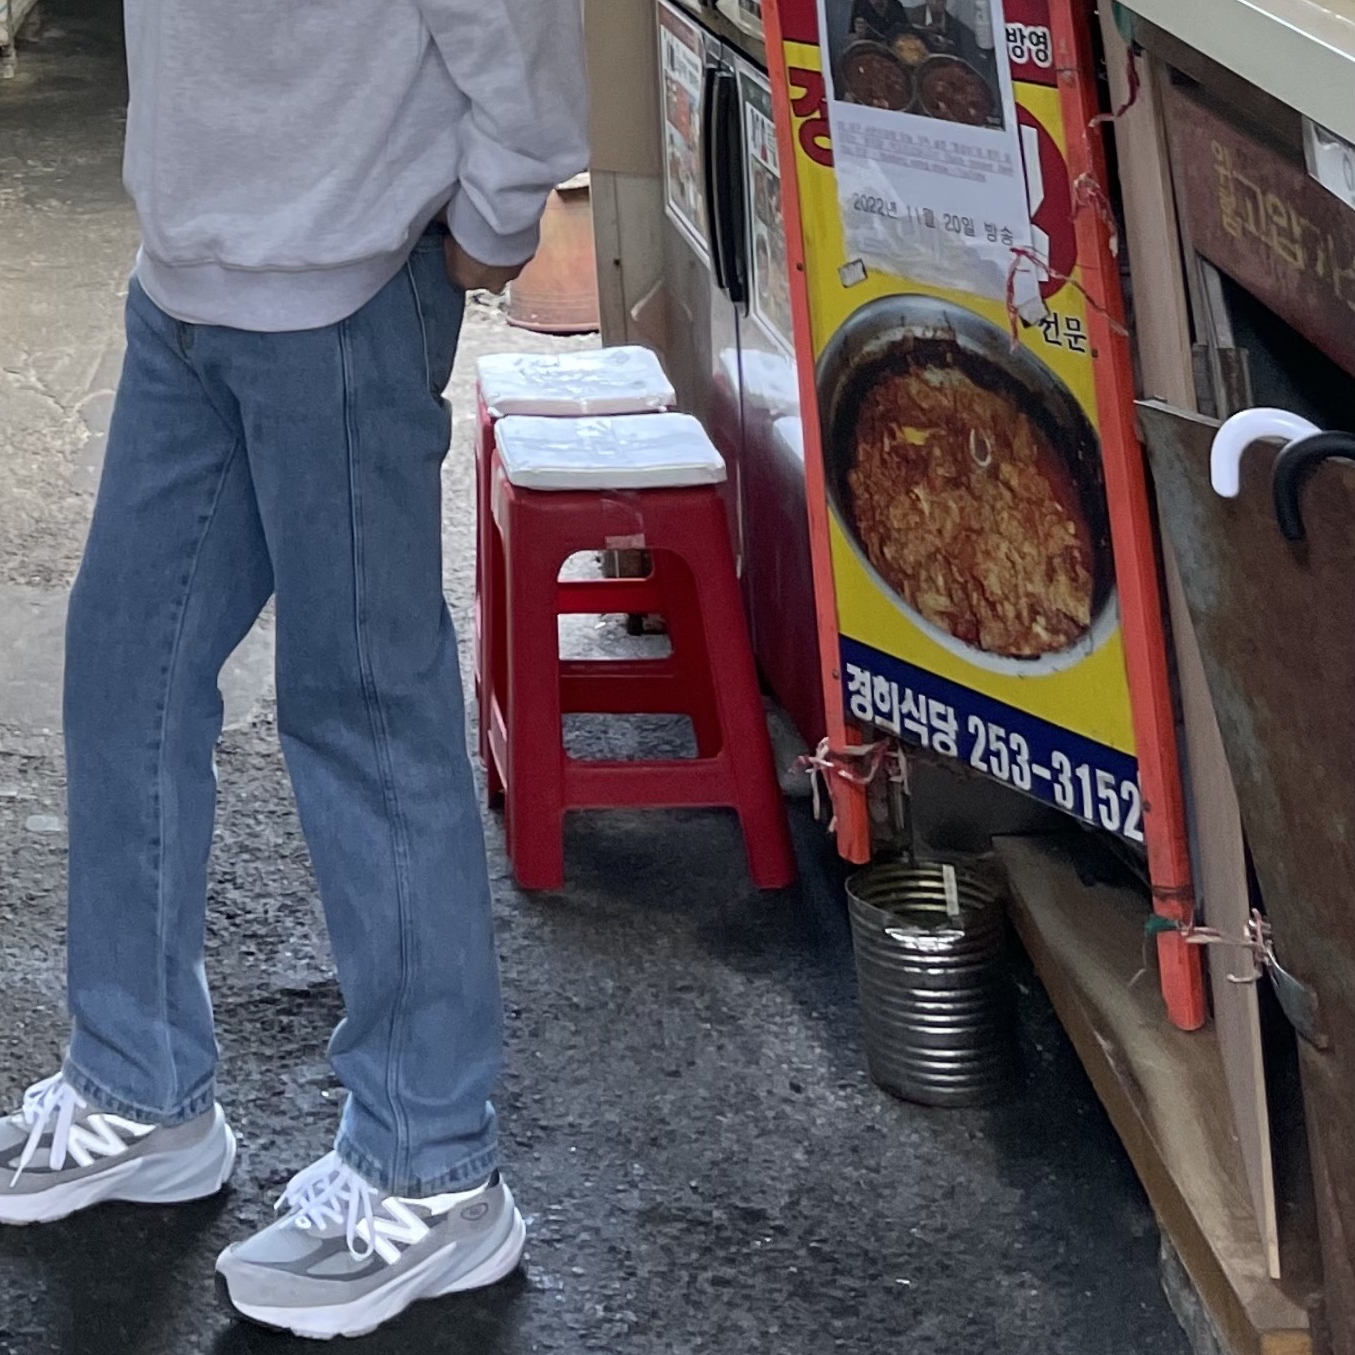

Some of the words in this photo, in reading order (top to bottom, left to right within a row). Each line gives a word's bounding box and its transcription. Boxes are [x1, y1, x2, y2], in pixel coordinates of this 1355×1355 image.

[1005, 26, 1050, 66] 방영
[853, 193, 897, 219] 2022년
[943, 212, 976, 238] 20일
[984, 220, 1014, 246] 방송
[845, 662, 959, 758] 경희식당
[967, 715, 1144, 844] 253-3152
